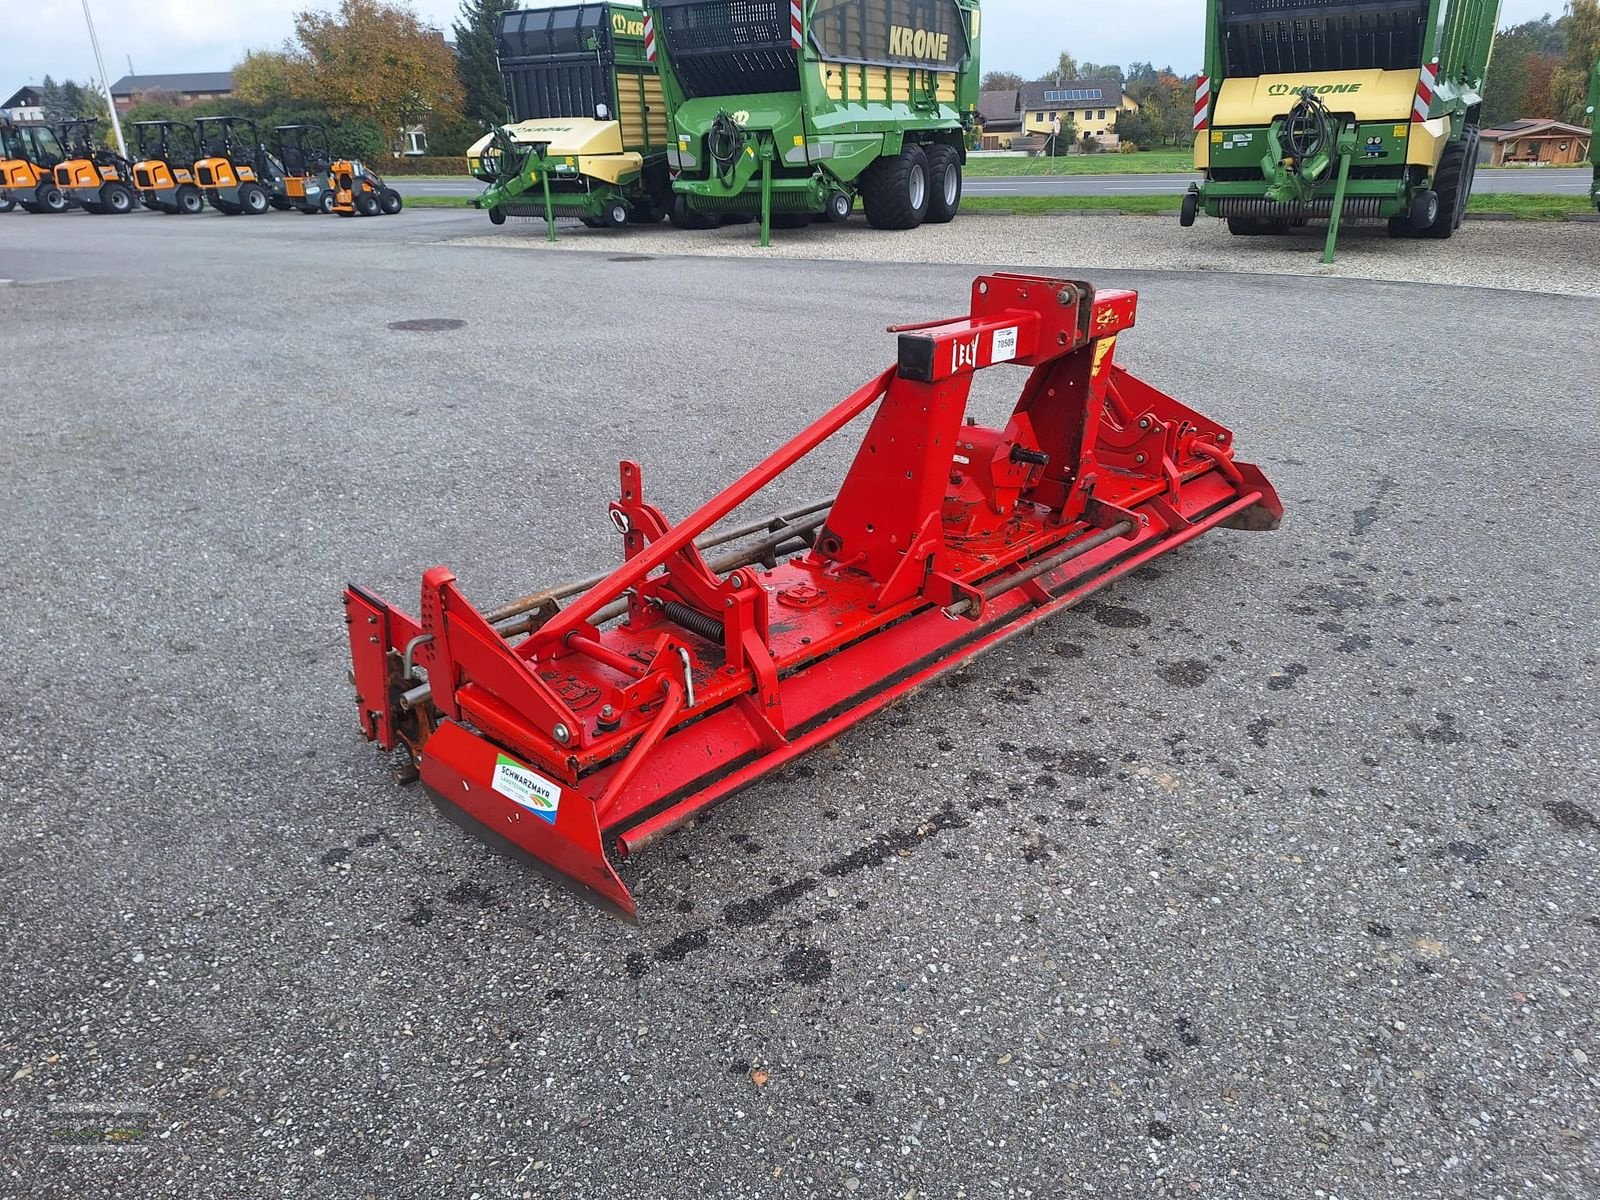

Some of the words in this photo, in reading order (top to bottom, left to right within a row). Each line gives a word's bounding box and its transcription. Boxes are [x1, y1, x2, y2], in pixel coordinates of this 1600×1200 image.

[889, 25, 949, 61] KRONE
[951, 332, 980, 375] LELY
[501, 766, 551, 799] SCHWARZMAYR
